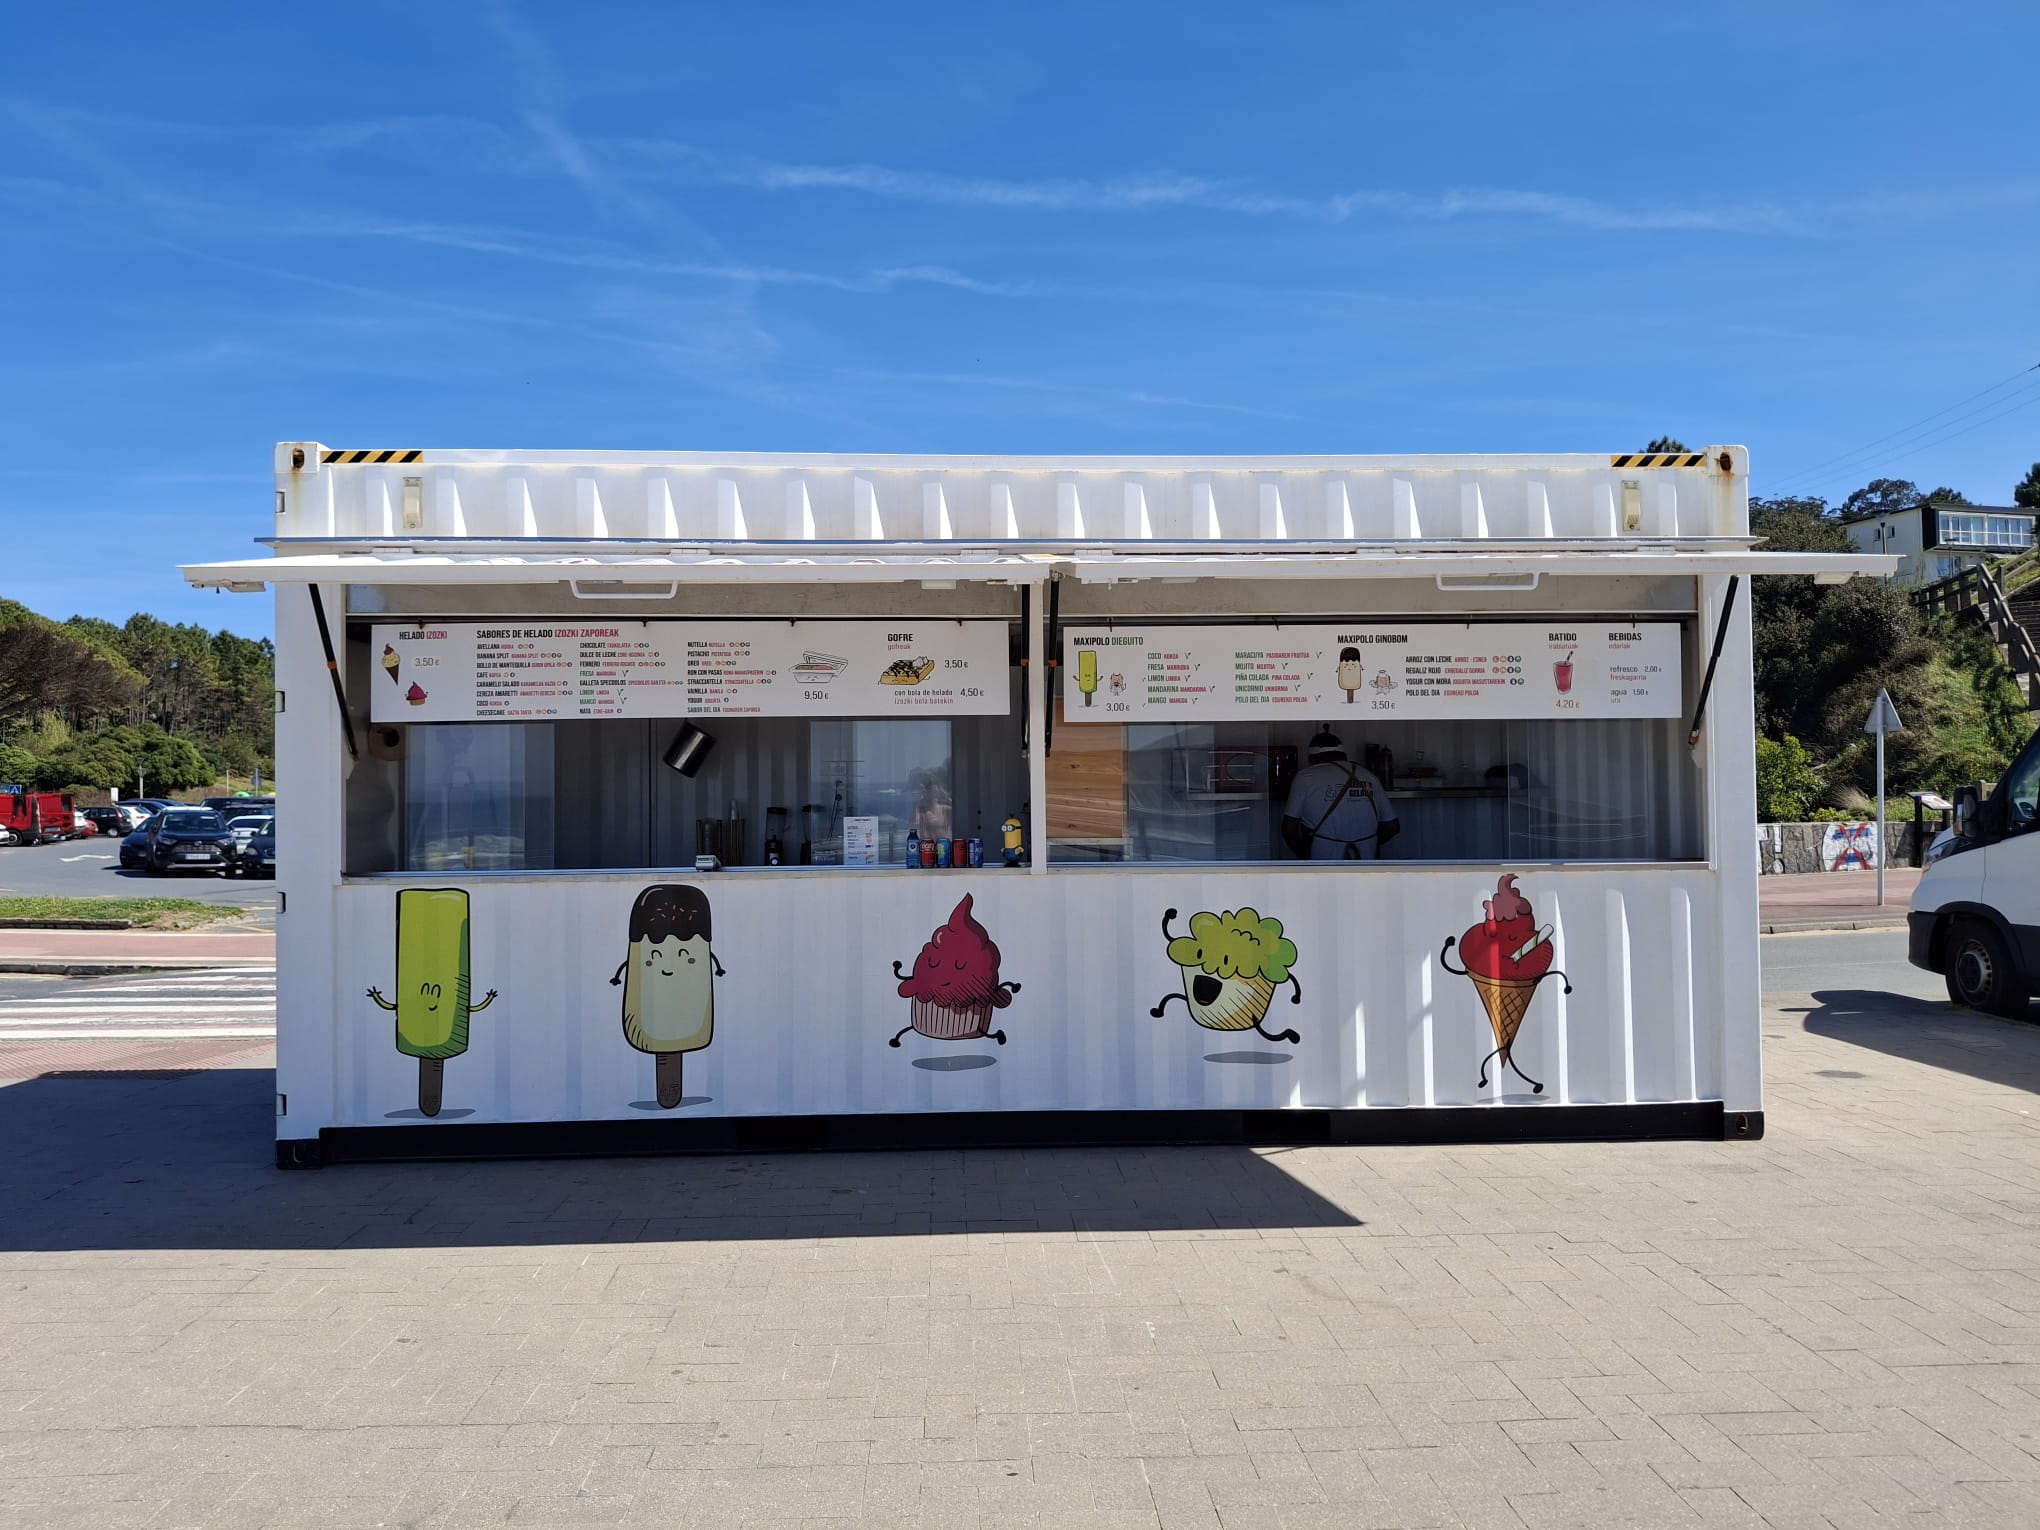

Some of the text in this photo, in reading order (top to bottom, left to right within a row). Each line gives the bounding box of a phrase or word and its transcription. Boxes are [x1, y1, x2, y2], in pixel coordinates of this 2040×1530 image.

[399, 631, 425, 640] HELADO
[476, 628, 619, 639] SABORES DE HELADO IZOZKI ZAPOREAK
[887, 633, 914, 642] GOFRE
[1548, 632, 1577, 641] BATIDO
[1608, 632, 1642, 641] BEBIDAS
[1073, 636, 1144, 646] MAXIPOLO DIEGUITO
[1337, 634, 1408, 644] MAXIPOLO GINOBOM
[1147, 652, 1162, 660] COCO
[1405, 655, 1422, 663] ARROZ
[1423, 655, 1435, 663] CON
[1435, 655, 1452, 663] LECHE
[944, 659, 963, 669] 3,50
[1147, 663, 1164, 671] FRESA
[1235, 662, 1254, 670] MOJITO
[1609, 665, 1638, 673] refresco
[1147, 674, 1164, 682] LIMON
[1235, 673, 1248, 681] PIÑA
[1248, 673, 1270, 681] COLADA
[959, 687, 979, 698] 4,50
[1147, 685, 1179, 693] MANDARINA
[1610, 689, 1628, 697] agua
[804, 690, 824, 700] 9,50
[1147, 696, 1167, 704] MANGO
[1106, 702, 1125, 712] 3,00
[1371, 700, 1390, 710] 3,50
[1349, 789, 1373, 798] GELAO
